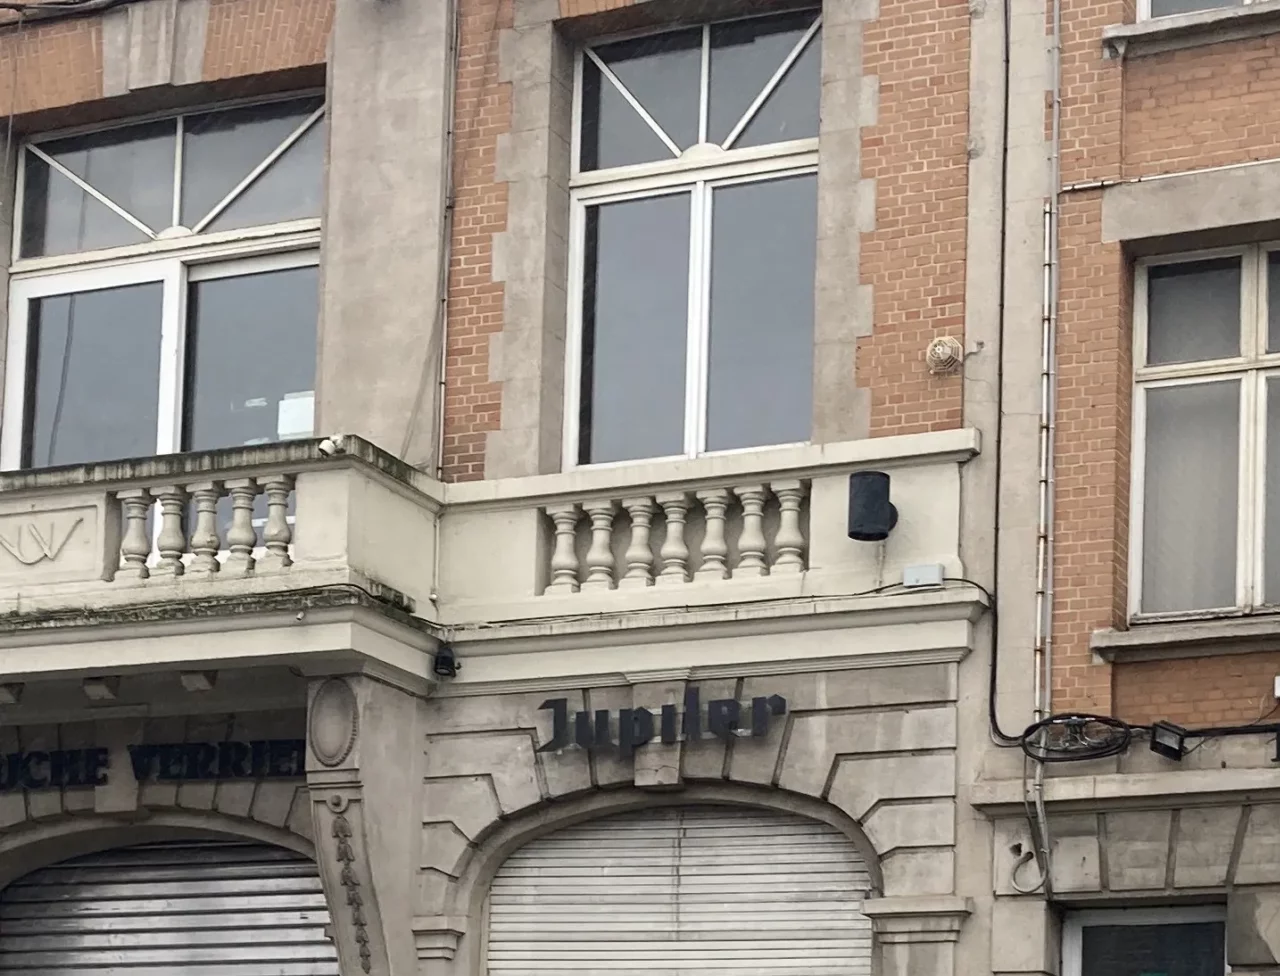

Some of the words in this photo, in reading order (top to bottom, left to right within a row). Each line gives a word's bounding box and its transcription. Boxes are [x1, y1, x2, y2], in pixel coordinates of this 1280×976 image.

[537, 687, 787, 758] Jupiler
[0, 747, 109, 792] UCHE
[127, 739, 305, 781] VERRIE
